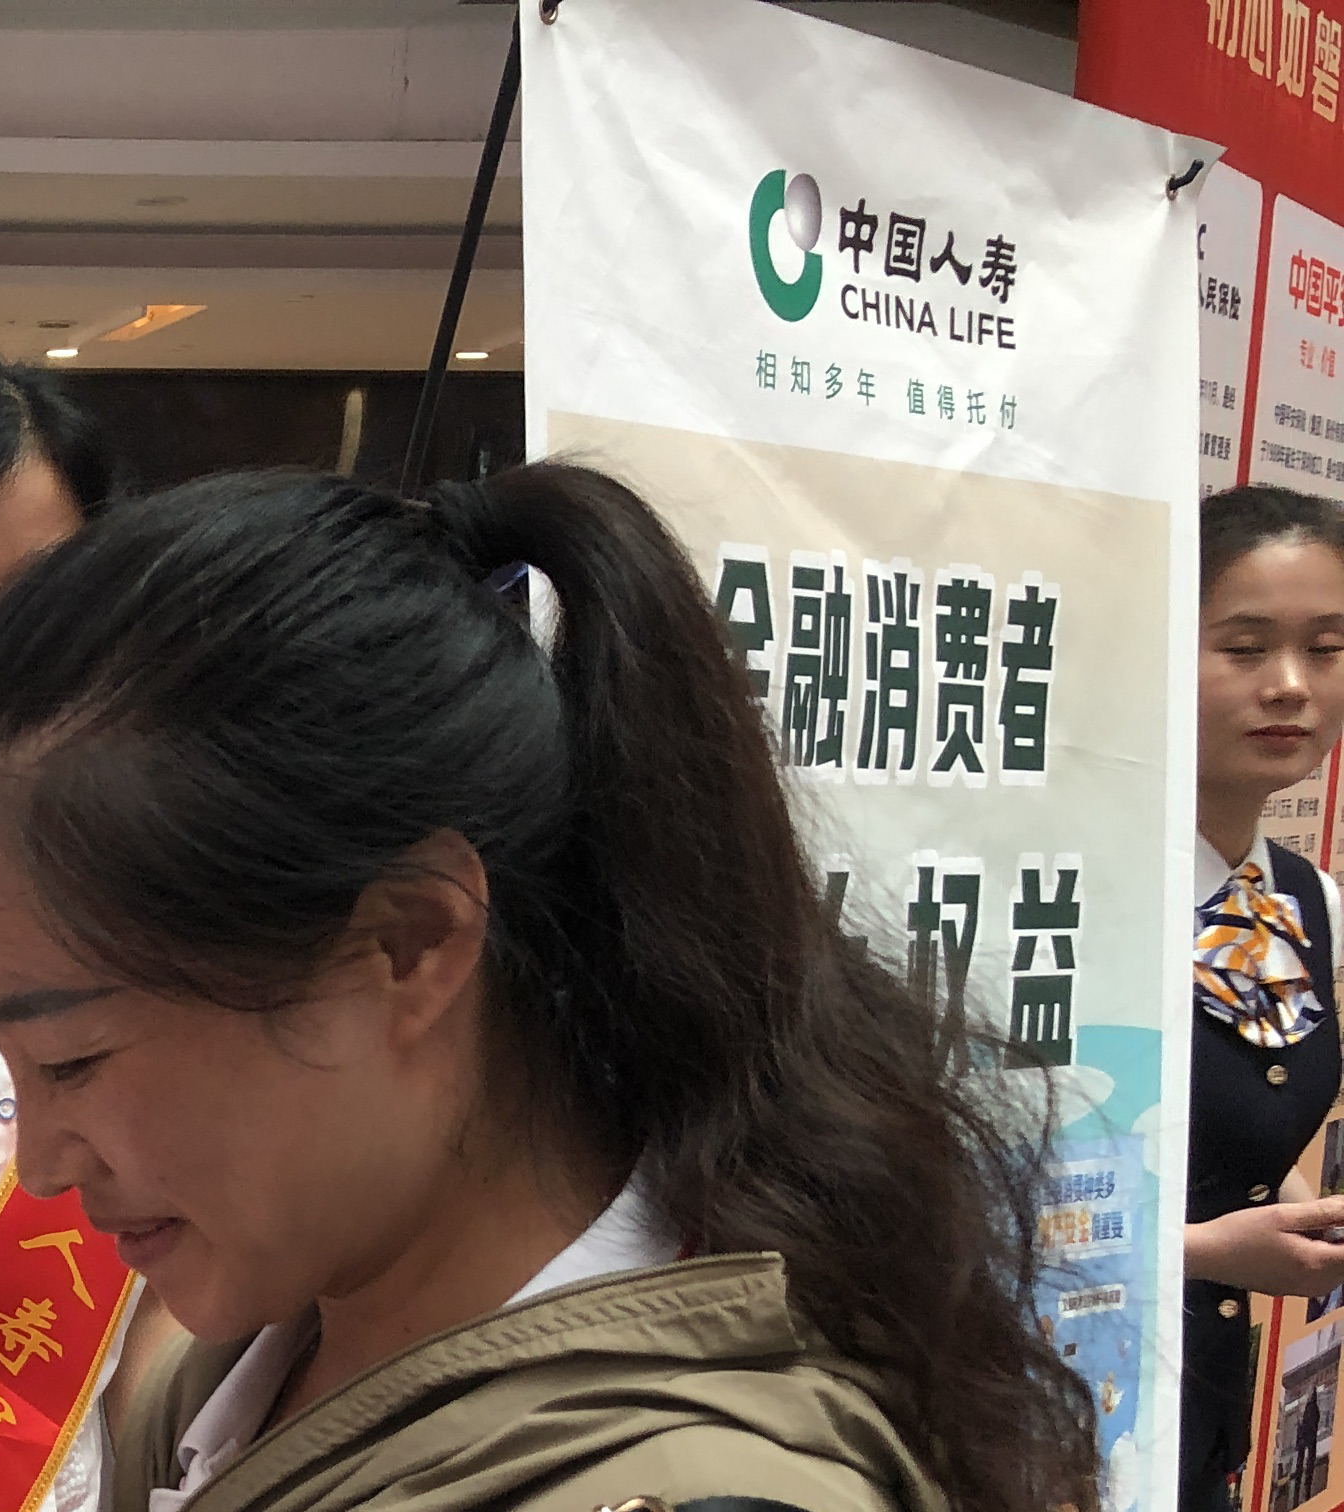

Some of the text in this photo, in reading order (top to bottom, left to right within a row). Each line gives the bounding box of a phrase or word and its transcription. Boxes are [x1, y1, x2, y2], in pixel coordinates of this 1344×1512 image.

[838, 198, 1017, 304] 中国人寿
[841, 284, 1016, 349] CHINA LIFE
[756, 349, 1017, 429] 相知多年 值得托付
[715, 557, 1057, 774] 金融消费者
[826, 868, 1081, 1073] 权益
